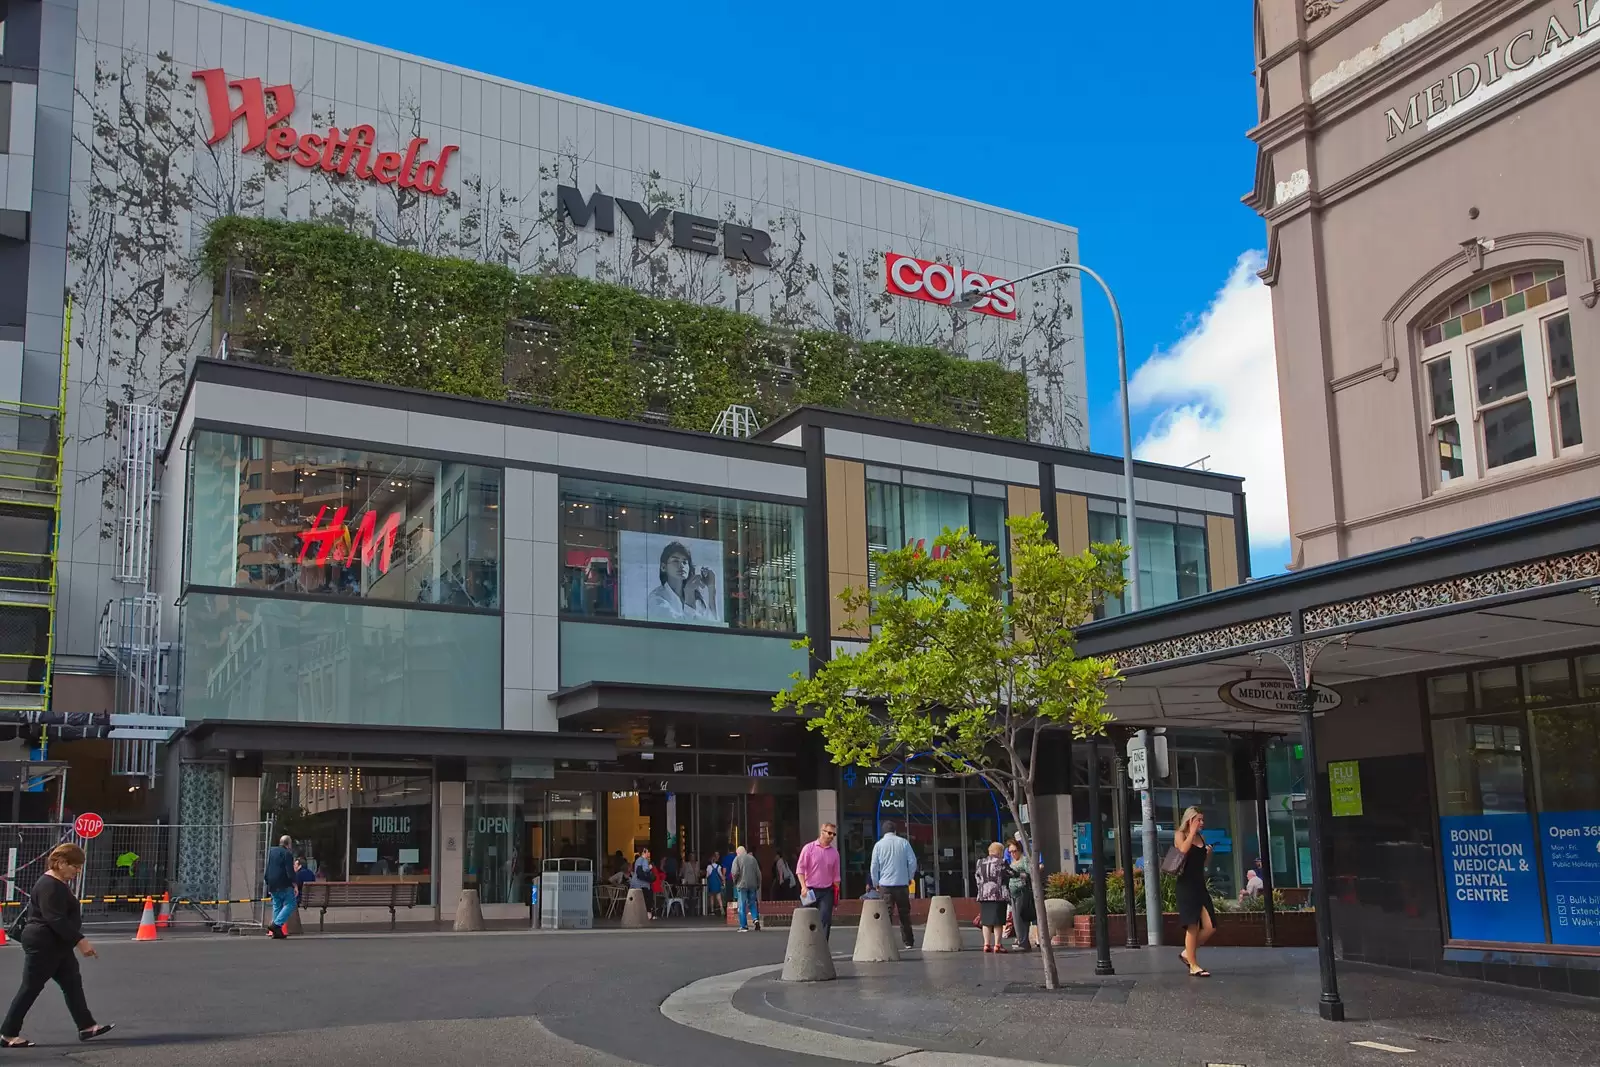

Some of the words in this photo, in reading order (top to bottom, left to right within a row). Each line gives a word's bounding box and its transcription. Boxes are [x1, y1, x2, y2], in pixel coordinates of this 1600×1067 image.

[1384, 0, 1600, 142] MEDICAL
[192, 68, 459, 196] Westfield
[557, 184, 772, 267] MYER
[891, 257, 1016, 314] coles
[296, 504, 401, 575] H&M
[1239, 688, 1285, 701] MEDICAL
[1133, 751, 1145, 762] ONE
[747, 762, 769, 776] VANS
[1333, 766, 1353, 778] FLU
[76, 818, 102, 832] STOP
[372, 816, 411, 833] PUBLIC
[478, 816, 509, 834] OPEN
[1450, 829, 1493, 842] BONDI
[1549, 826, 1581, 840] Open
[1452, 843, 1523, 857] JUNCTION
[1453, 858, 1515, 872] MEDICAL
[1518, 858, 1530, 872] &
[1455, 873, 1508, 887] DENTAL
[1456, 888, 1509, 902] CENTRE
[1570, 895, 1588, 905] Bulk
[1571, 906, 1600, 916] Extend
